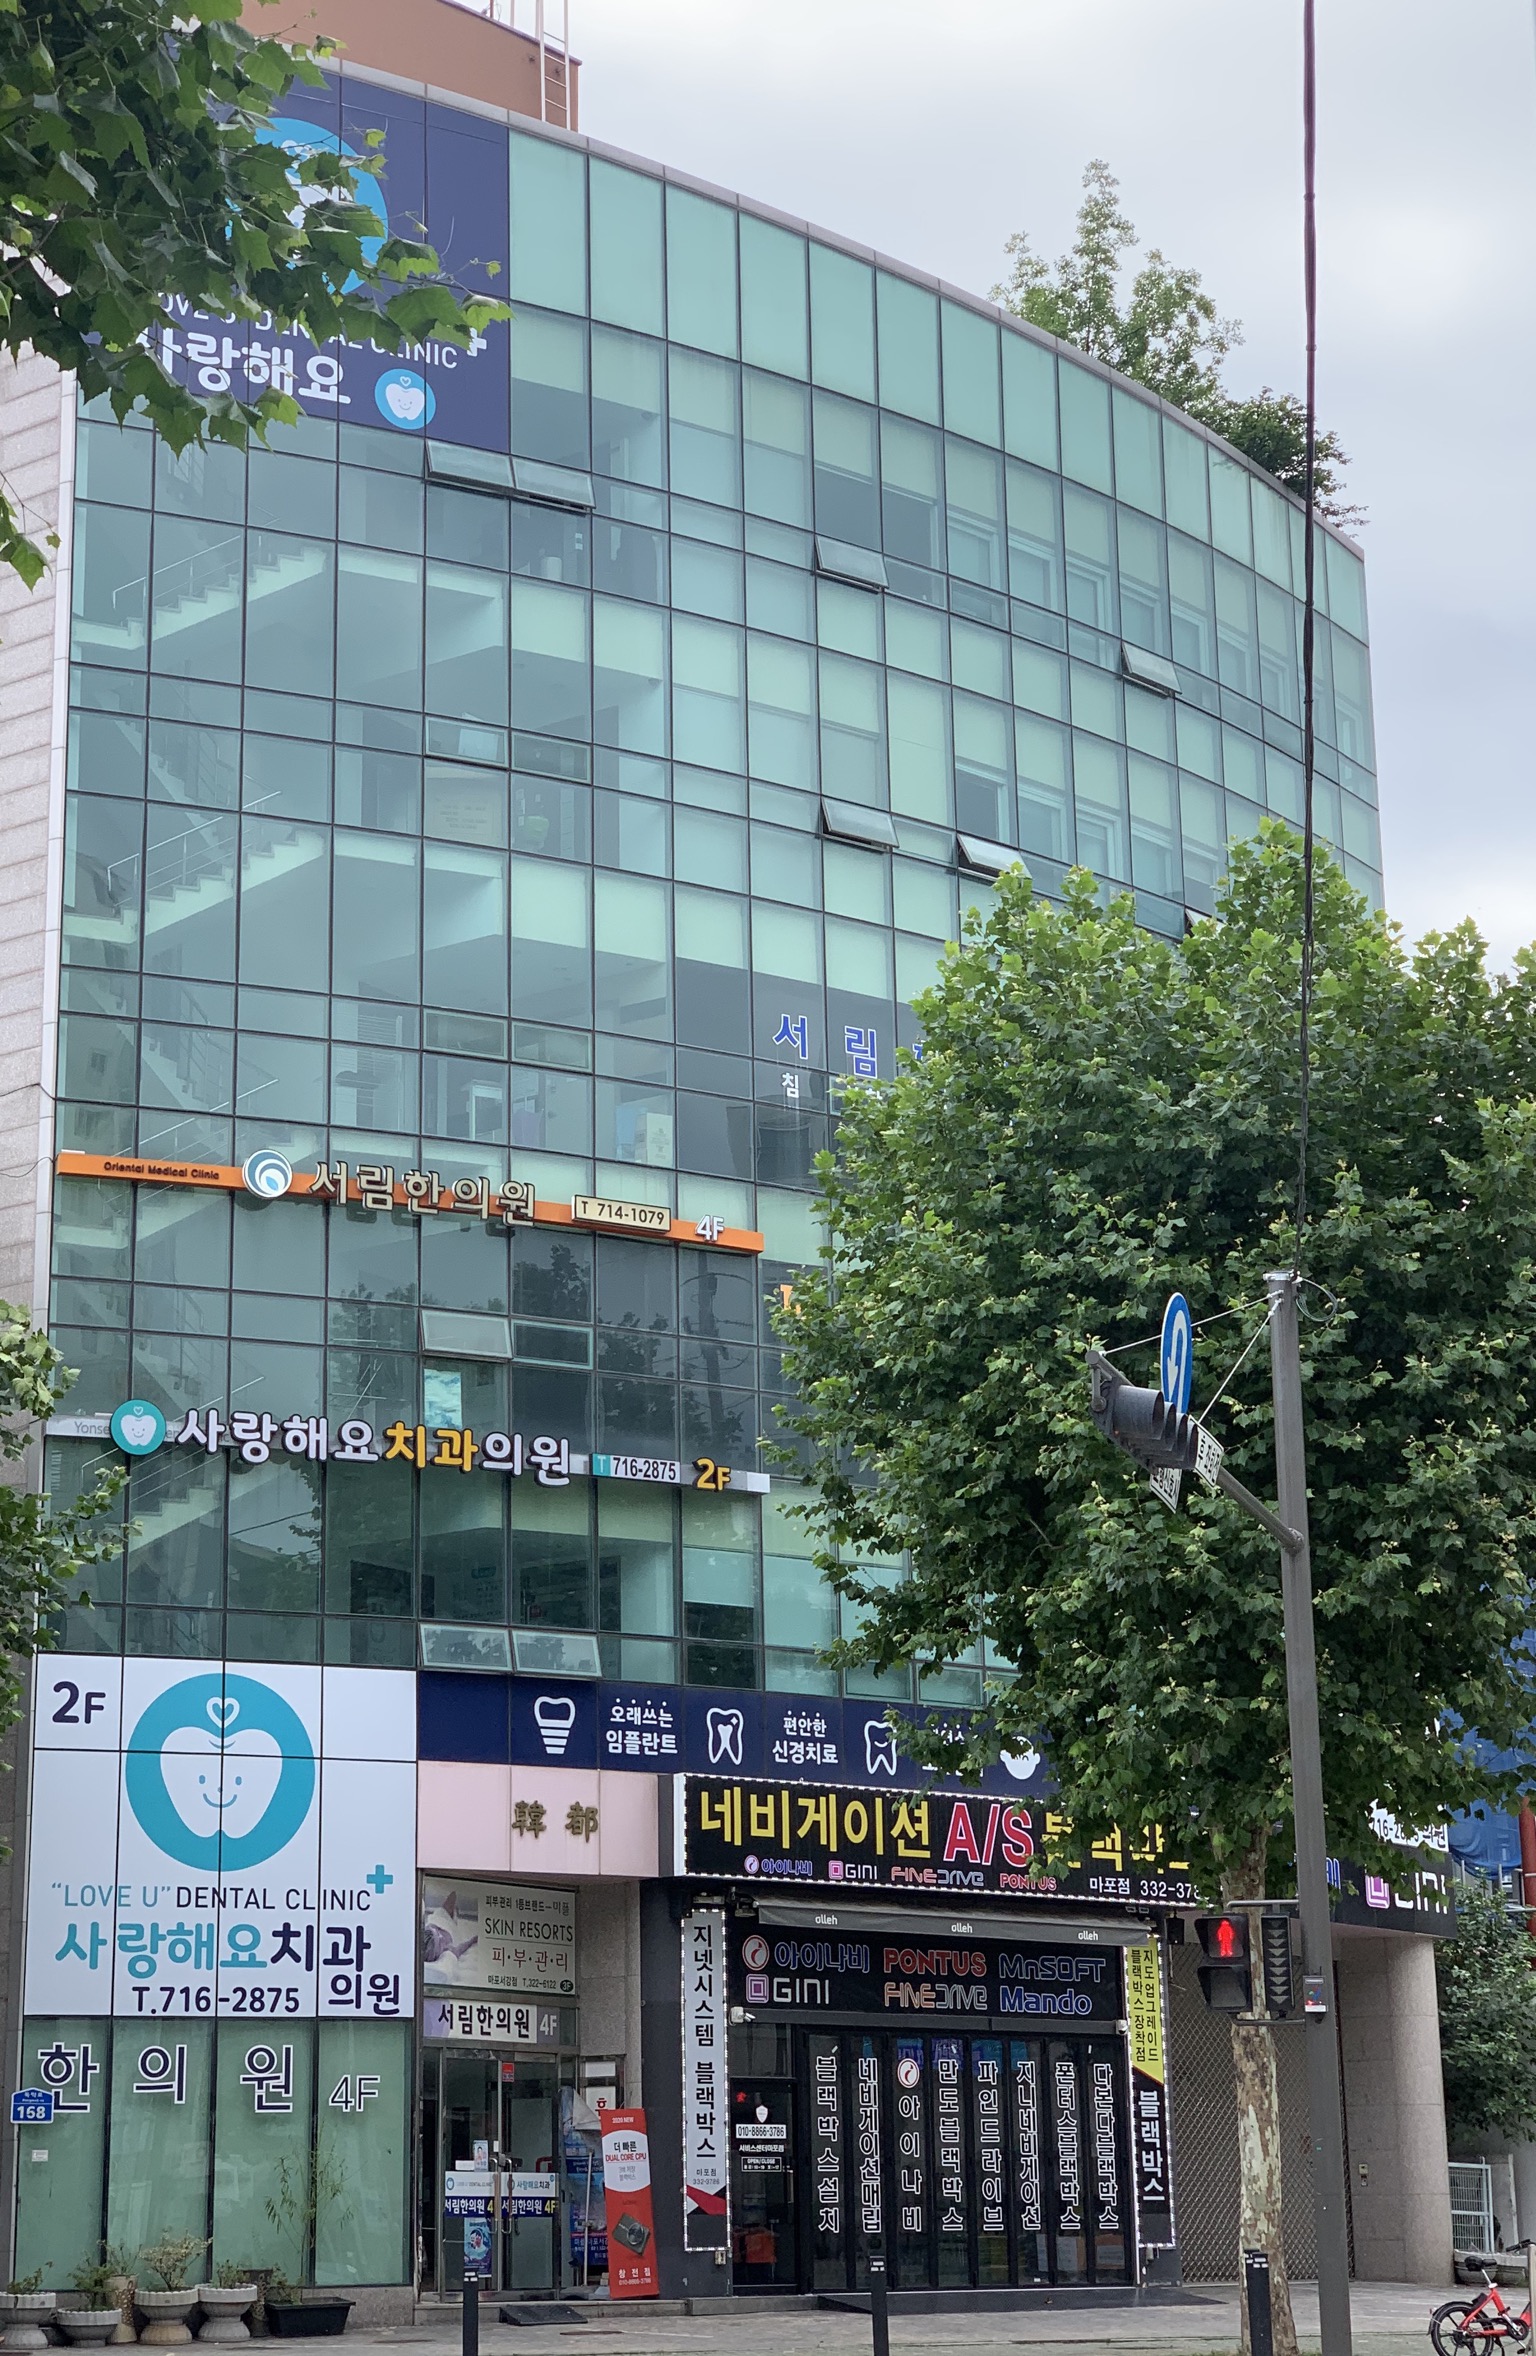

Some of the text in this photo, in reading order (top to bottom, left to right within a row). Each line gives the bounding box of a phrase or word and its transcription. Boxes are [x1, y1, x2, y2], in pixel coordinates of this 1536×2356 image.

[103, 1161, 220, 1181] Oriental Medical Clinic
[308, 1161, 536, 1228] 서림한의원
[581, 1200, 665, 1226] T 714-1079
[694, 1214, 725, 1242] 4F
[74, 1420, 112, 1436] Yonse
[612, 1457, 677, 1481] 716-2875
[693, 1457, 731, 1491] 2F
[52, 1680, 106, 1724] 2F
[609, 1704, 674, 1729] 오래쓰는
[783, 1714, 827, 1738] 편안한
[605, 1730, 679, 1757] 임플란트
[771, 1741, 839, 1766] 신경치료
[700, 1786, 932, 1860] 네비게이션
[942, 1801, 1034, 1869] A/S
[760, 1858, 813, 1877] 아이나비
[845, 1863, 878, 1881] GINI
[999, 1872, 1058, 1892] PONTUS
[175, 1886, 276, 1910] DENTAL
[285, 1888, 371, 1912] CLINIC
[1089, 1876, 1211, 1901] 마포점 332-378
[484, 1917, 574, 1942] SKIN RESORTS
[814, 1914, 838, 1926] olleh
[951, 1922, 973, 1934] olleh
[1077, 1929, 1099, 1941] olleh
[55, 1921, 372, 1980] 사랑해요치과
[773, 1941, 871, 1974] 아이나비
[882, 1948, 987, 1978] PONTUS
[131, 1985, 300, 2015] T.716-2875
[327, 1973, 401, 2016] 의원
[772, 1976, 830, 2005] GINI
[1000, 1985, 1093, 2016] Mando
[438, 2003, 559, 2039] 서림한의원 4F
[693, 1924, 717, 2158] 지넷시스템 블랙박스
[328, 2074, 381, 2113] 4F
[17, 2105, 46, 2120] 168
[635, 2152, 647, 2160] CPU
[815, 2055, 840, 2234] 블랙박스설치
[858, 2057, 882, 2234] 네비게이션매립
[937, 2058, 964, 2232] 만도블랙박스
[977, 2060, 1005, 2232] 파인드라이브
[1016, 2060, 1042, 2231] 지니네비게이션
[1055, 2061, 1081, 2231] 폰터스블랙박스
[1092, 2063, 1120, 2230] 다본다블랙박스
[1138, 2090, 1165, 2201] 블랙박스
[898, 2095, 923, 2232] 아이나비
[444, 2198, 485, 2215] 서림한의원
[501, 2198, 556, 2215] 서림한의원 4F
